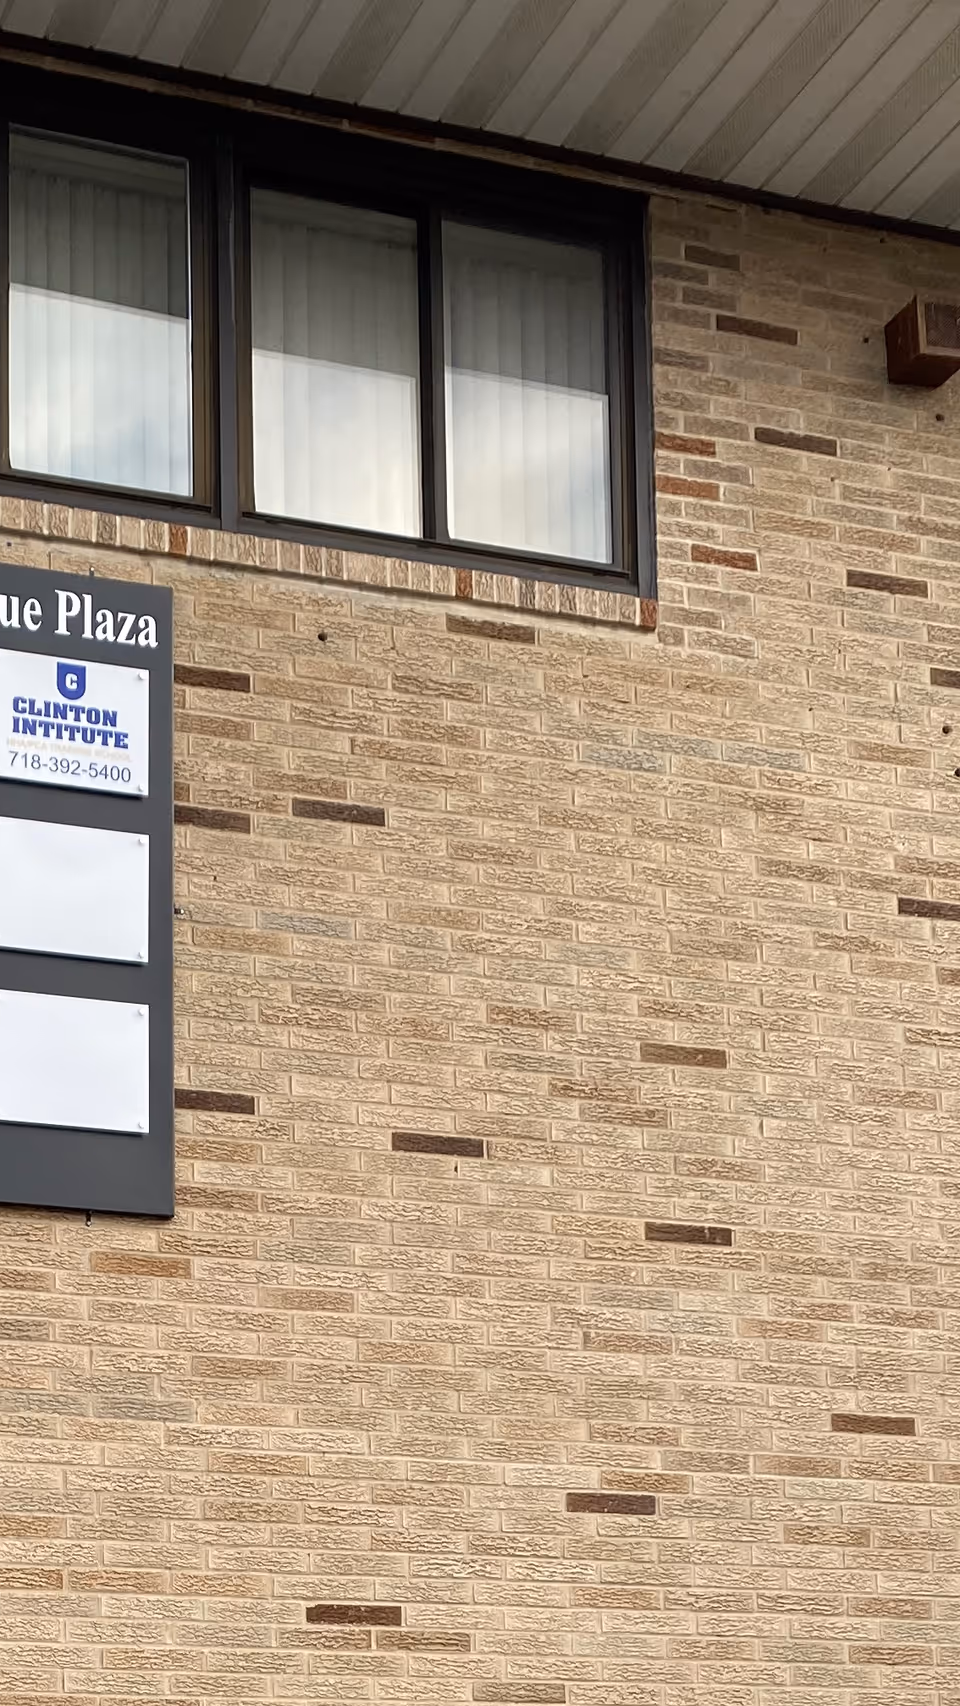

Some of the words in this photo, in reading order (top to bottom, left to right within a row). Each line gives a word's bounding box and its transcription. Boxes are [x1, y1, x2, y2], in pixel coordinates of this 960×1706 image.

[54, 589, 160, 649] Plaza
[12, 696, 118, 728] CLINTON
[12, 716, 129, 750] INTITUTE
[8, 750, 132, 783] 718-392-5400
